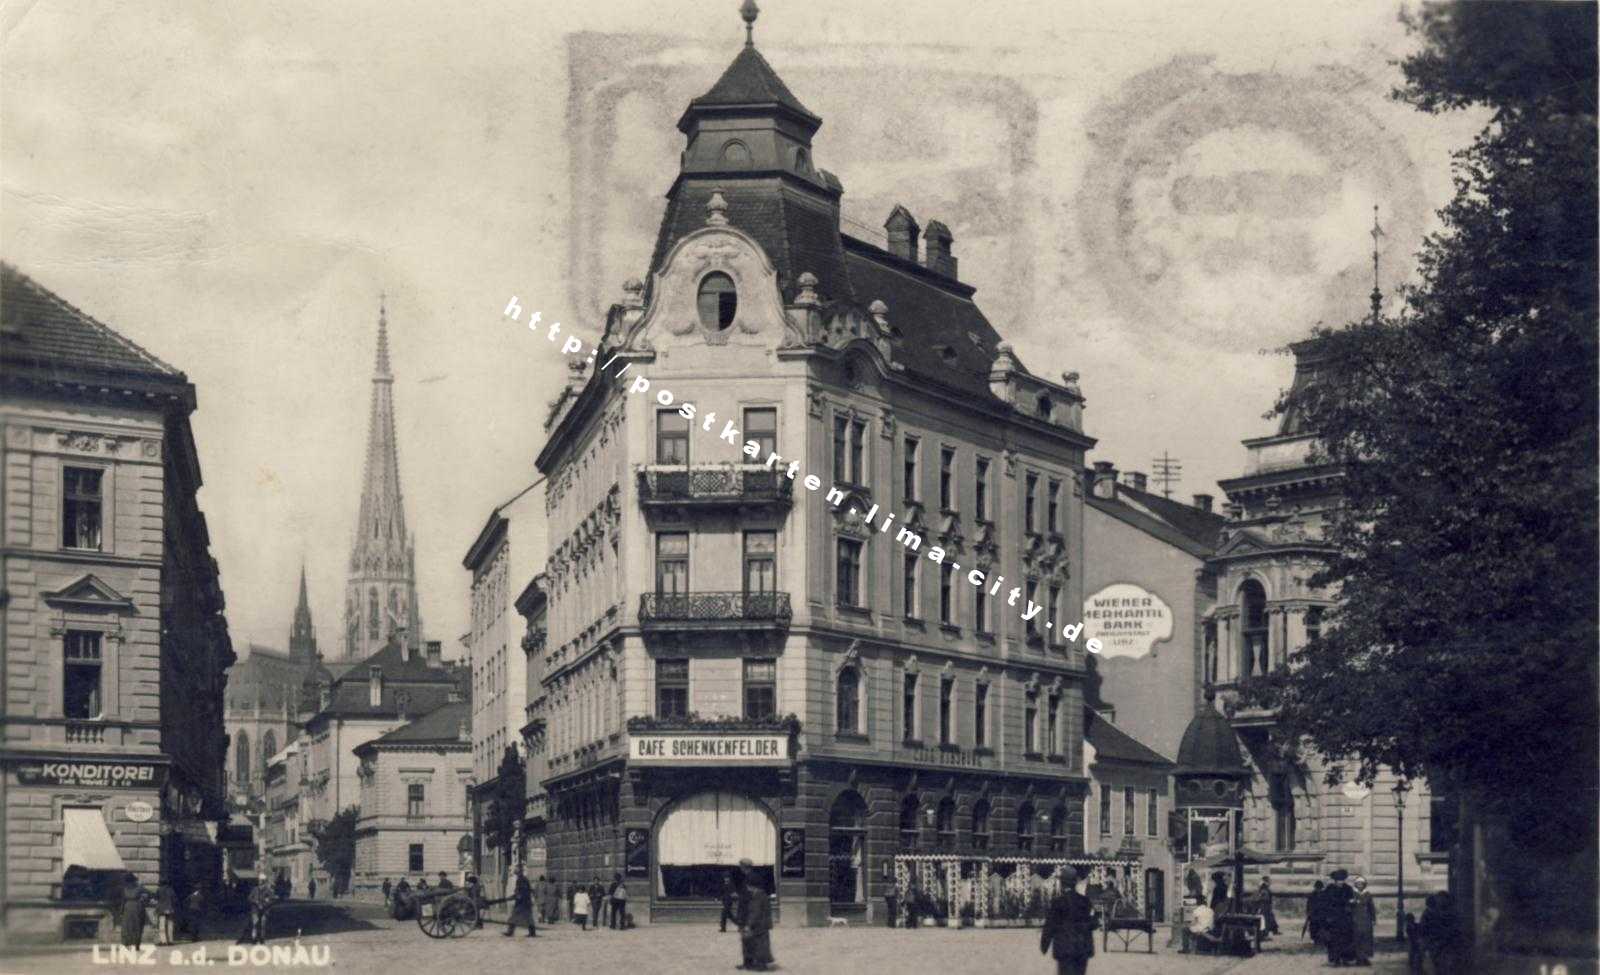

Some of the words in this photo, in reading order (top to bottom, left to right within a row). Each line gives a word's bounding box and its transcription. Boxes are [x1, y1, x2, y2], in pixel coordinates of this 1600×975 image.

[1094, 598, 1152, 607] WIENER
[1103, 621, 1143, 630] BANK
[638, 739, 666, 756] CAFE
[672, 739, 779, 756] SCHENKENFELDER
[42, 763, 154, 780] KONDITOREI
